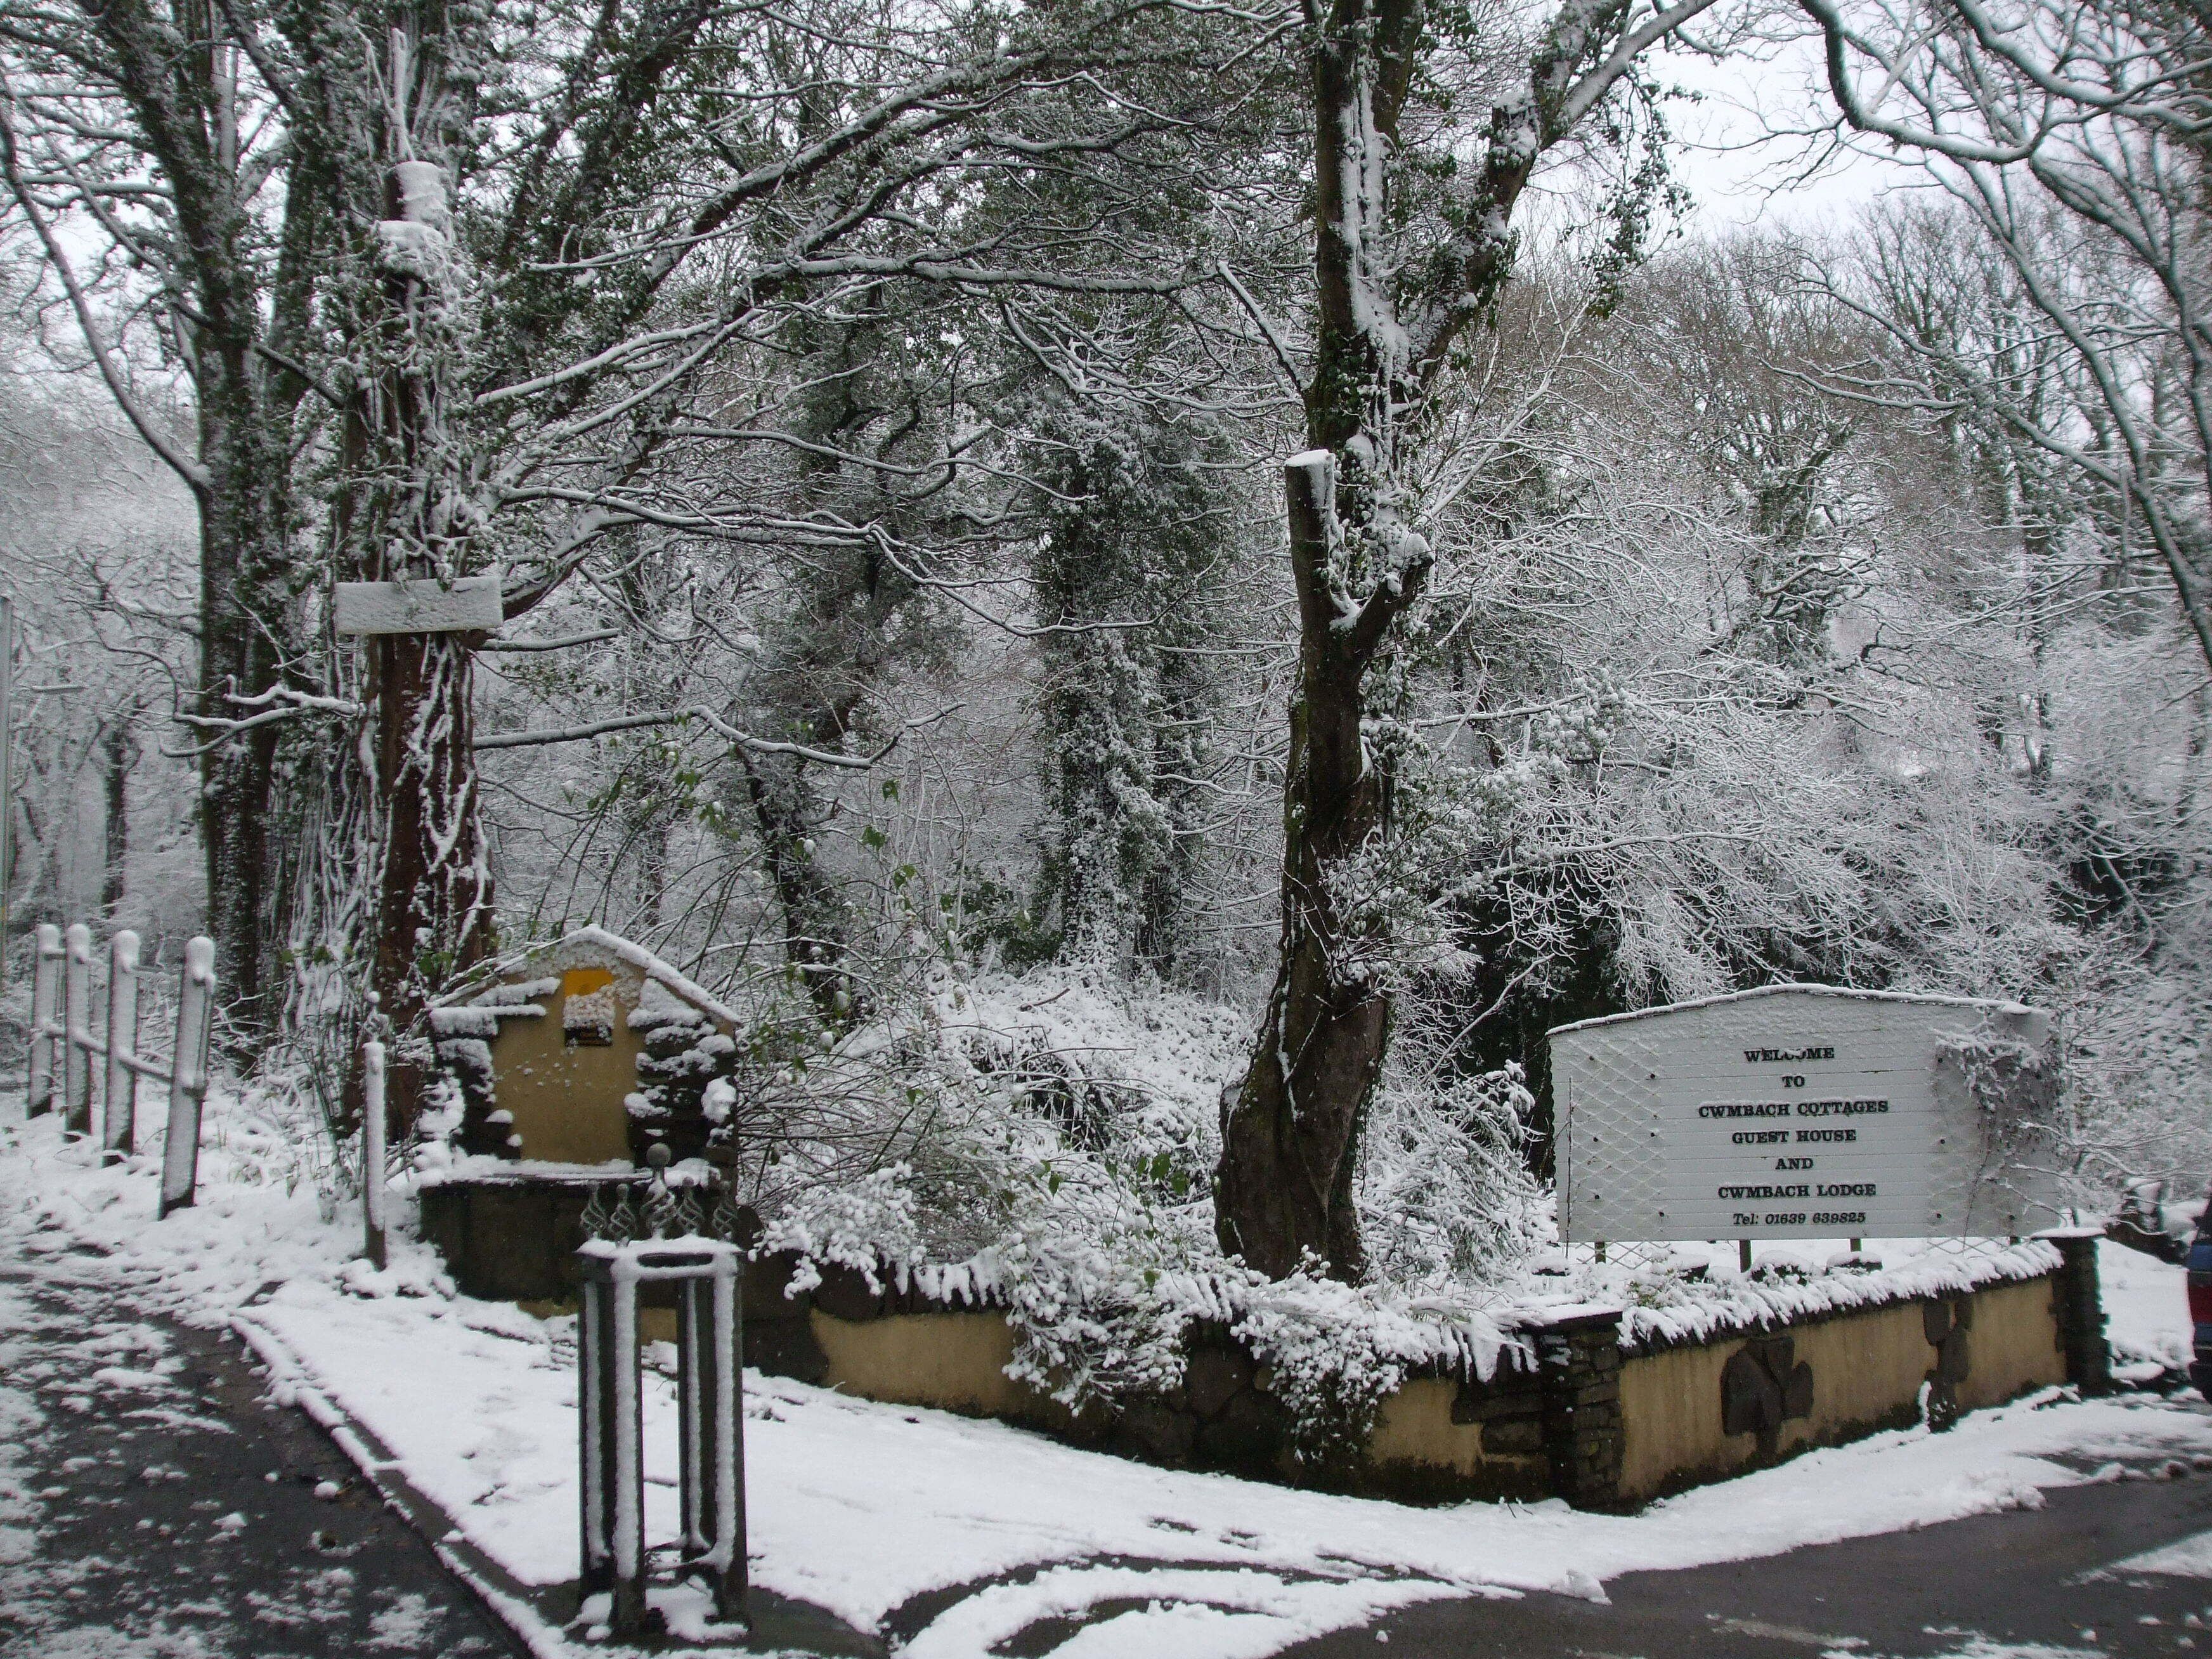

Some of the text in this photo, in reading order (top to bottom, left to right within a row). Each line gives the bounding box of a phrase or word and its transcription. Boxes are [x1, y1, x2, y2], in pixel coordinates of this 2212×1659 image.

[1782, 1076, 1805, 1087] TO
[1698, 1100, 1889, 1118] CWMBACH COTTAGES
[1732, 1129, 1856, 1143] GUEST HOUSE
[1775, 1158, 1814, 1169] AND
[1718, 1184, 1877, 1199] CWMBACH LODGE
[1733, 1212, 1866, 1225] Tel: 01639 639825
